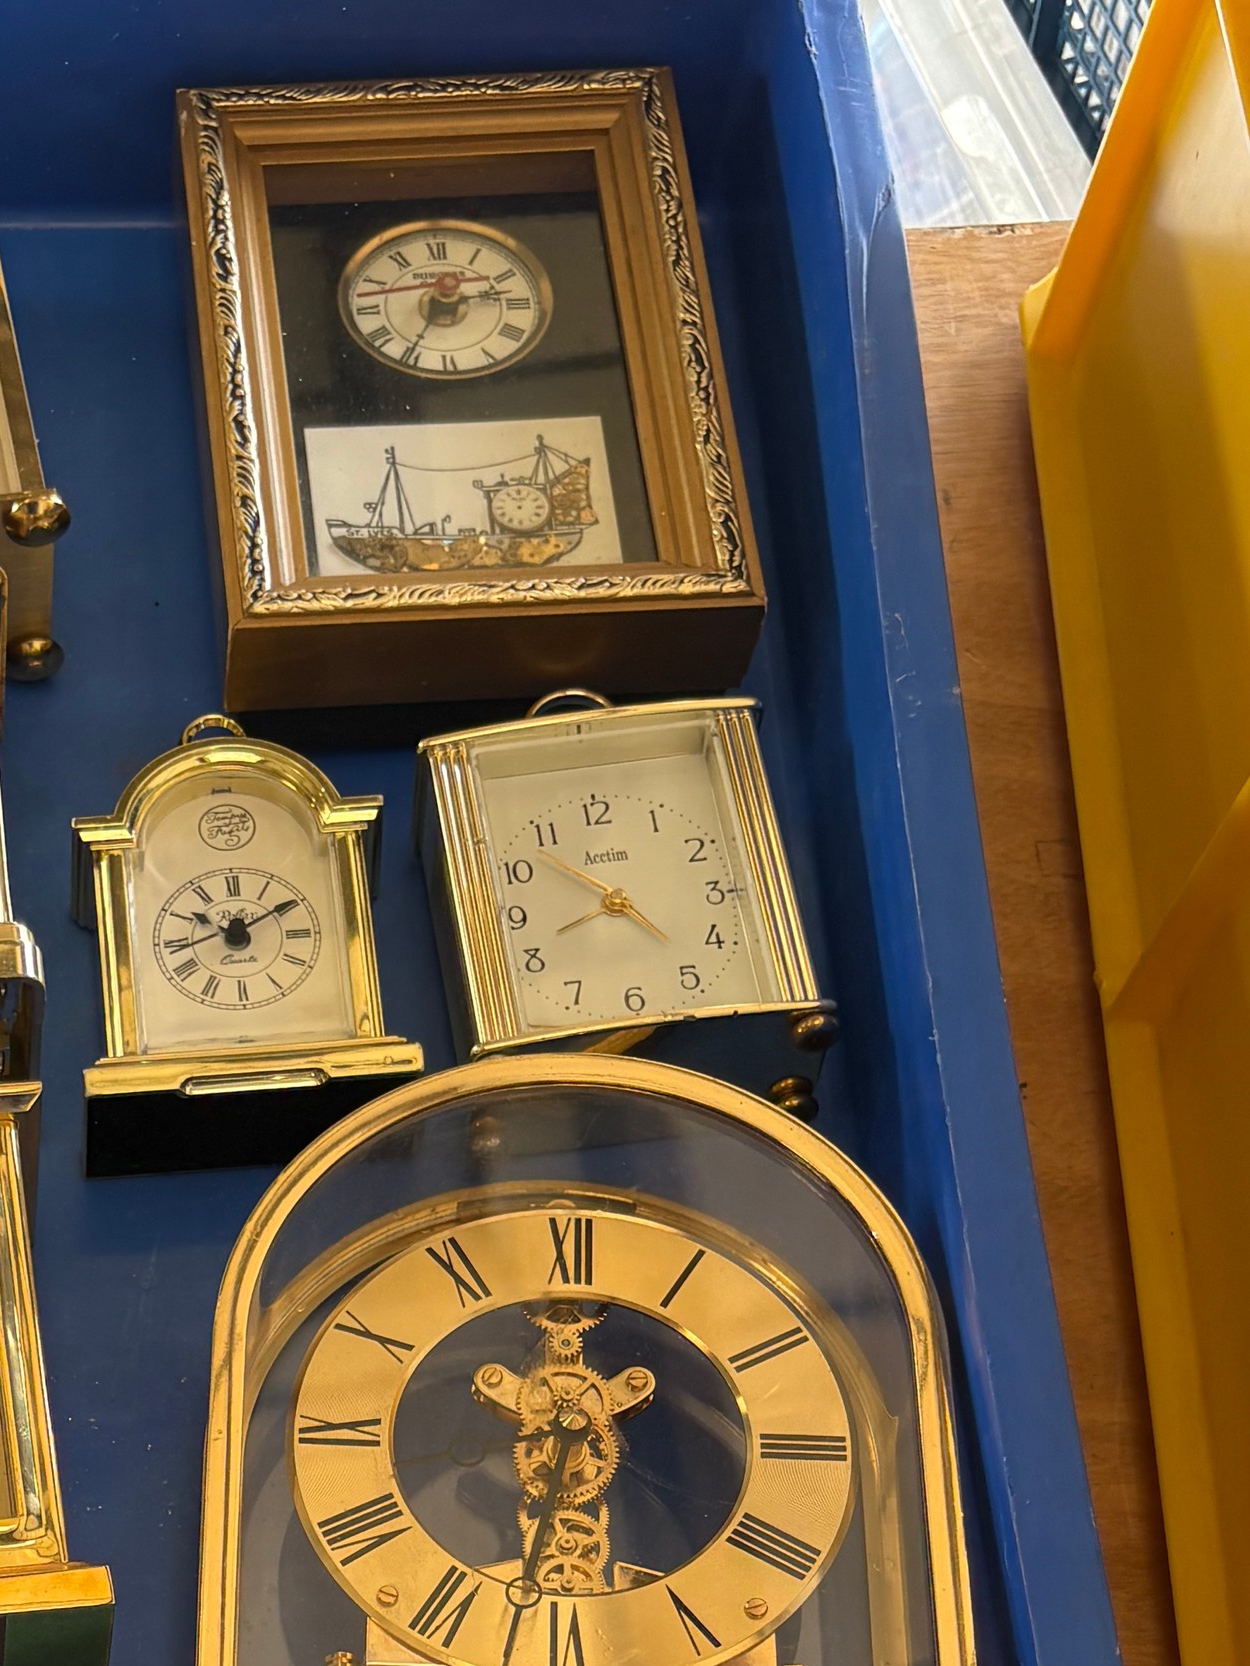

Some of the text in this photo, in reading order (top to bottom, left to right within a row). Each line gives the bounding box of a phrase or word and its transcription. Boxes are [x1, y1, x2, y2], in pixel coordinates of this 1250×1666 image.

[583, 800, 612, 826] 12
[650, 809, 659, 833] 1
[534, 822, 559, 847] 11
[584, 848, 629, 866] Acctim
[684, 838, 707, 863] 2
[504, 860, 534, 885] 10
[705, 881, 726, 905] 3
[508, 906, 527, 930] 9
[704, 924, 725, 949] 4
[523, 948, 546, 973] 8
[679, 965, 700, 990] 5
[564, 980, 582, 1005] 7
[624, 987, 646, 1012] 6
[548, 1217, 593, 1285] XII
[727, 1327, 810, 1374] II
[760, 1433, 848, 1462] III
